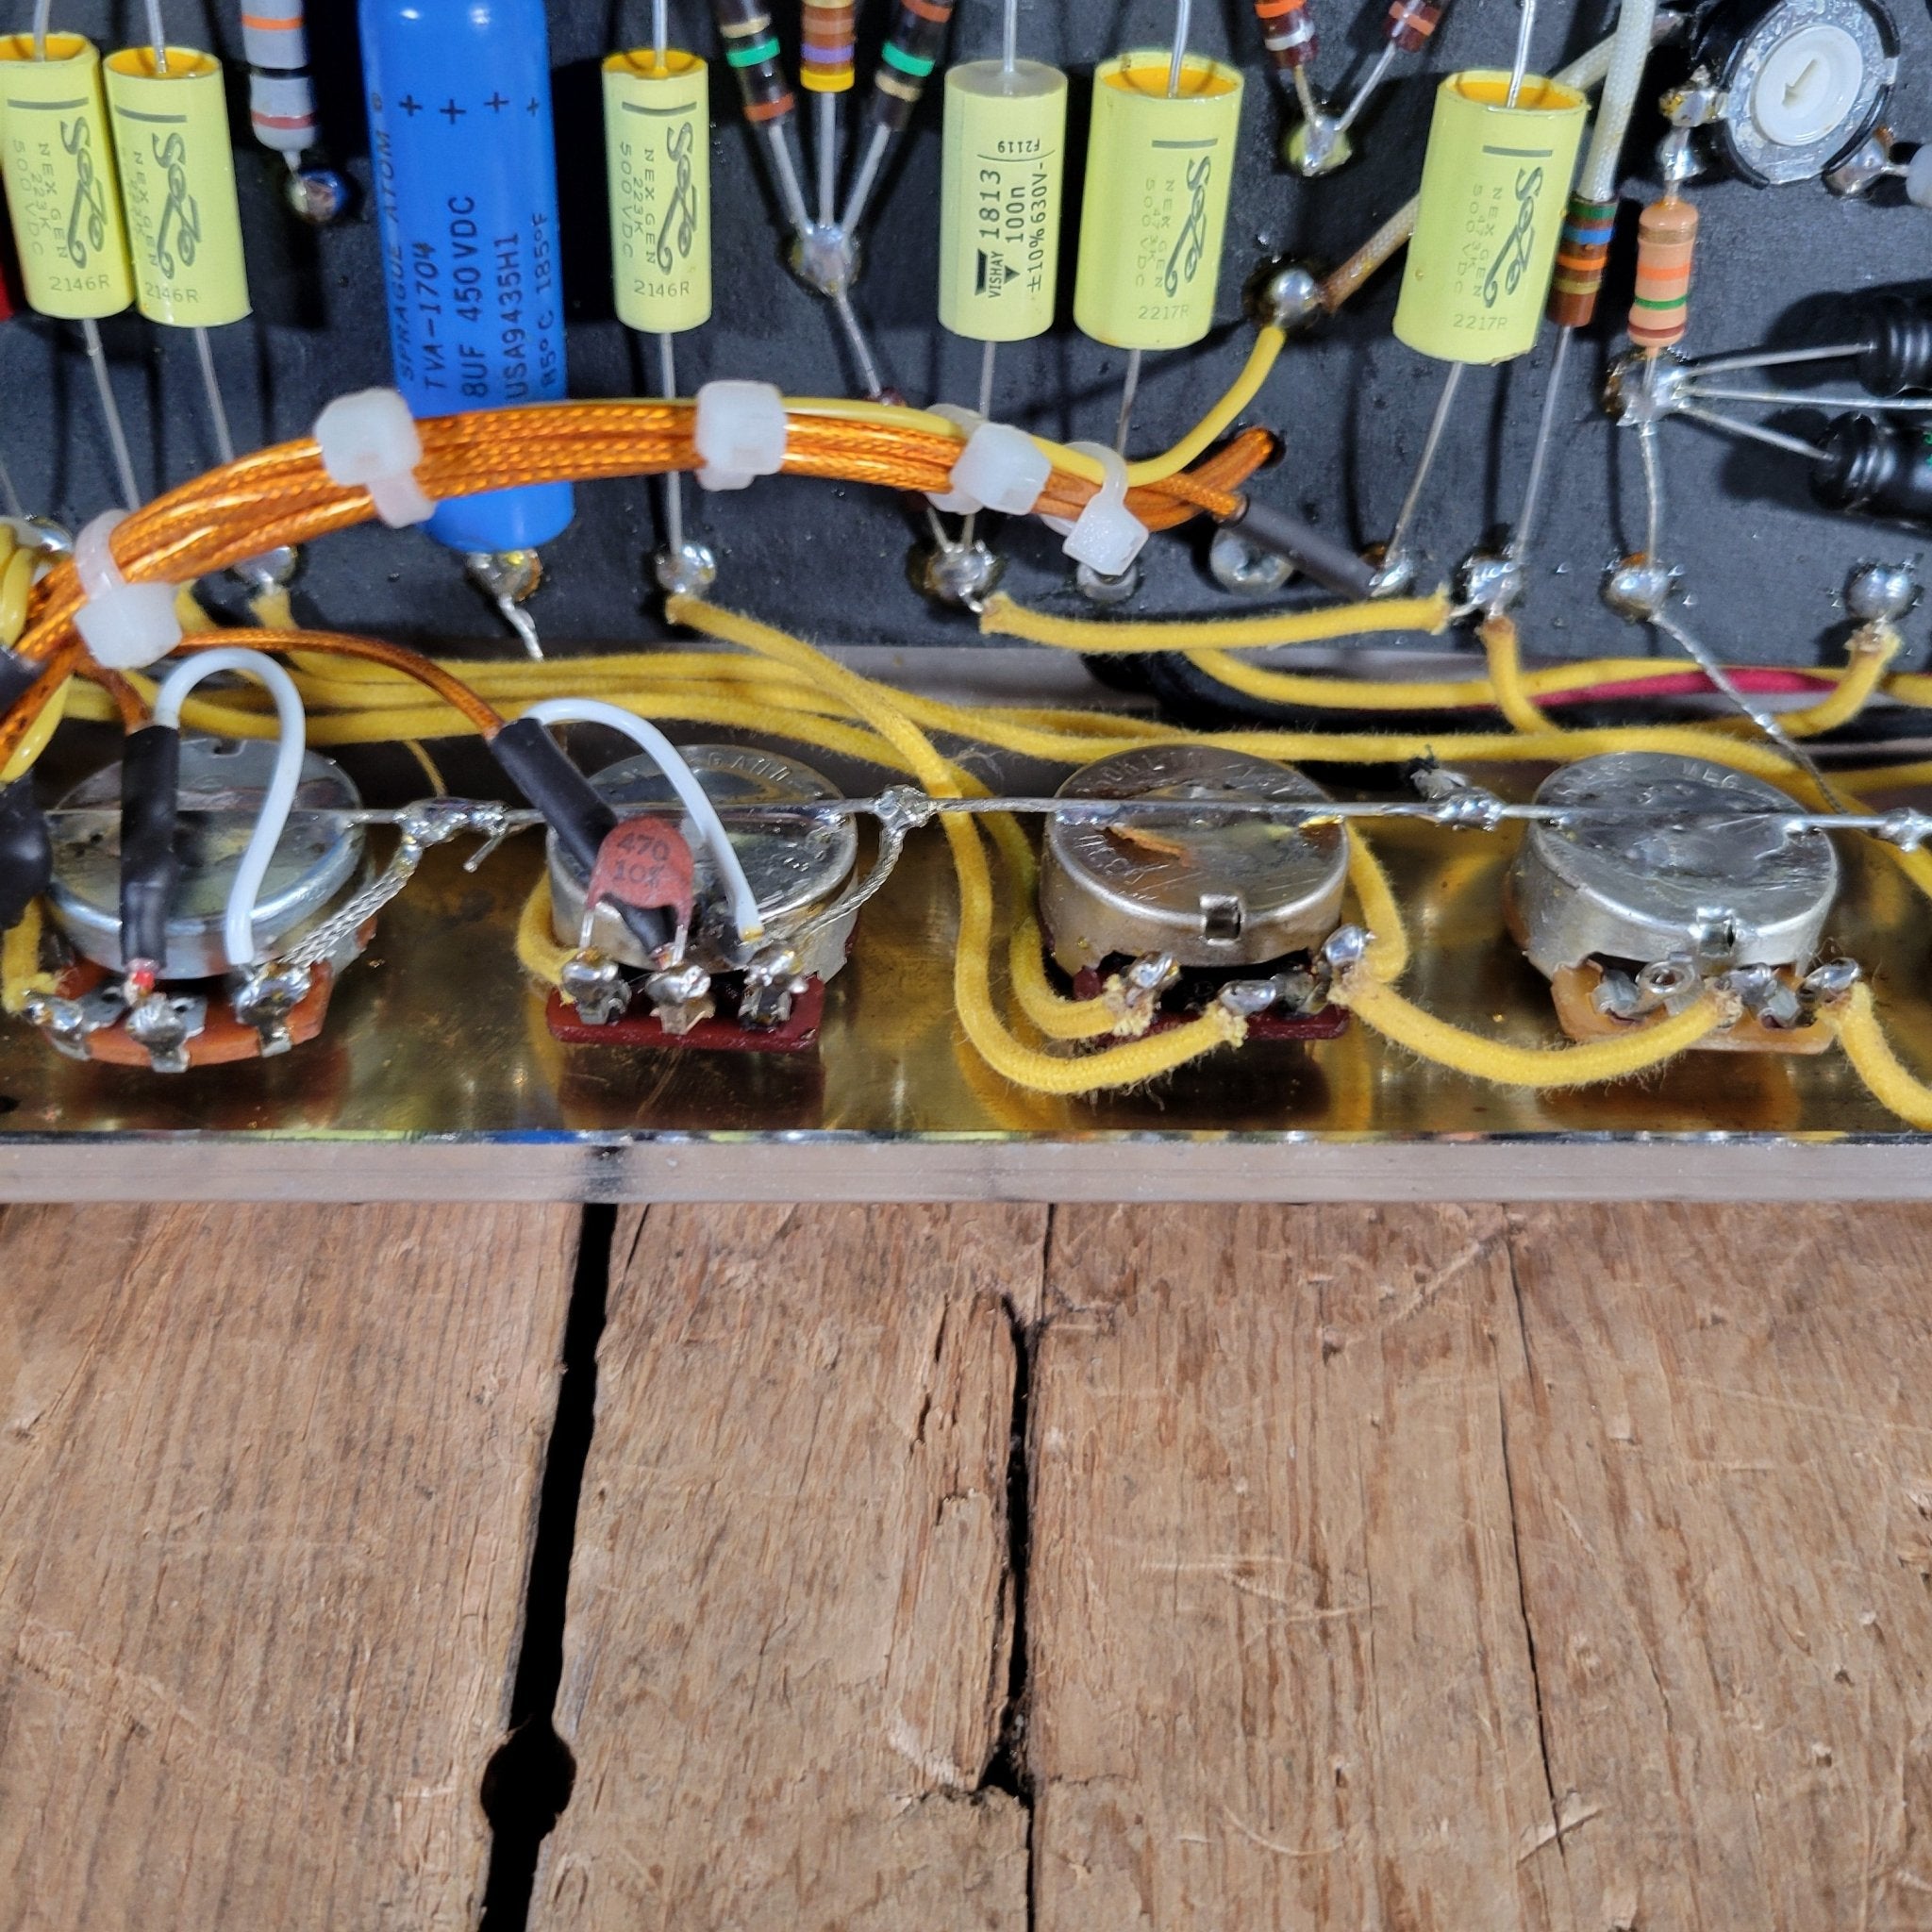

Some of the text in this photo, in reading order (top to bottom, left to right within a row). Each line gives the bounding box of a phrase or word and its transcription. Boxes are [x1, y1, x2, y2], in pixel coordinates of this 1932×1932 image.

[39, 142, 69, 258] NEX GEN
[633, 176, 644, 235] 223K
[643, 148, 657, 264] NEX GEN
[978, 169, 1001, 240] 1813
[1005, 186, 1026, 244] 100n
[48, 275, 110, 292] 2146R
[144, 282, 200, 304] 2146R
[633, 280, 690, 299] 2146R
[988, 250, 1005, 299] VISHAY
[458, 343, 489, 398] 8UF
[617, 831, 671, 862] 470
